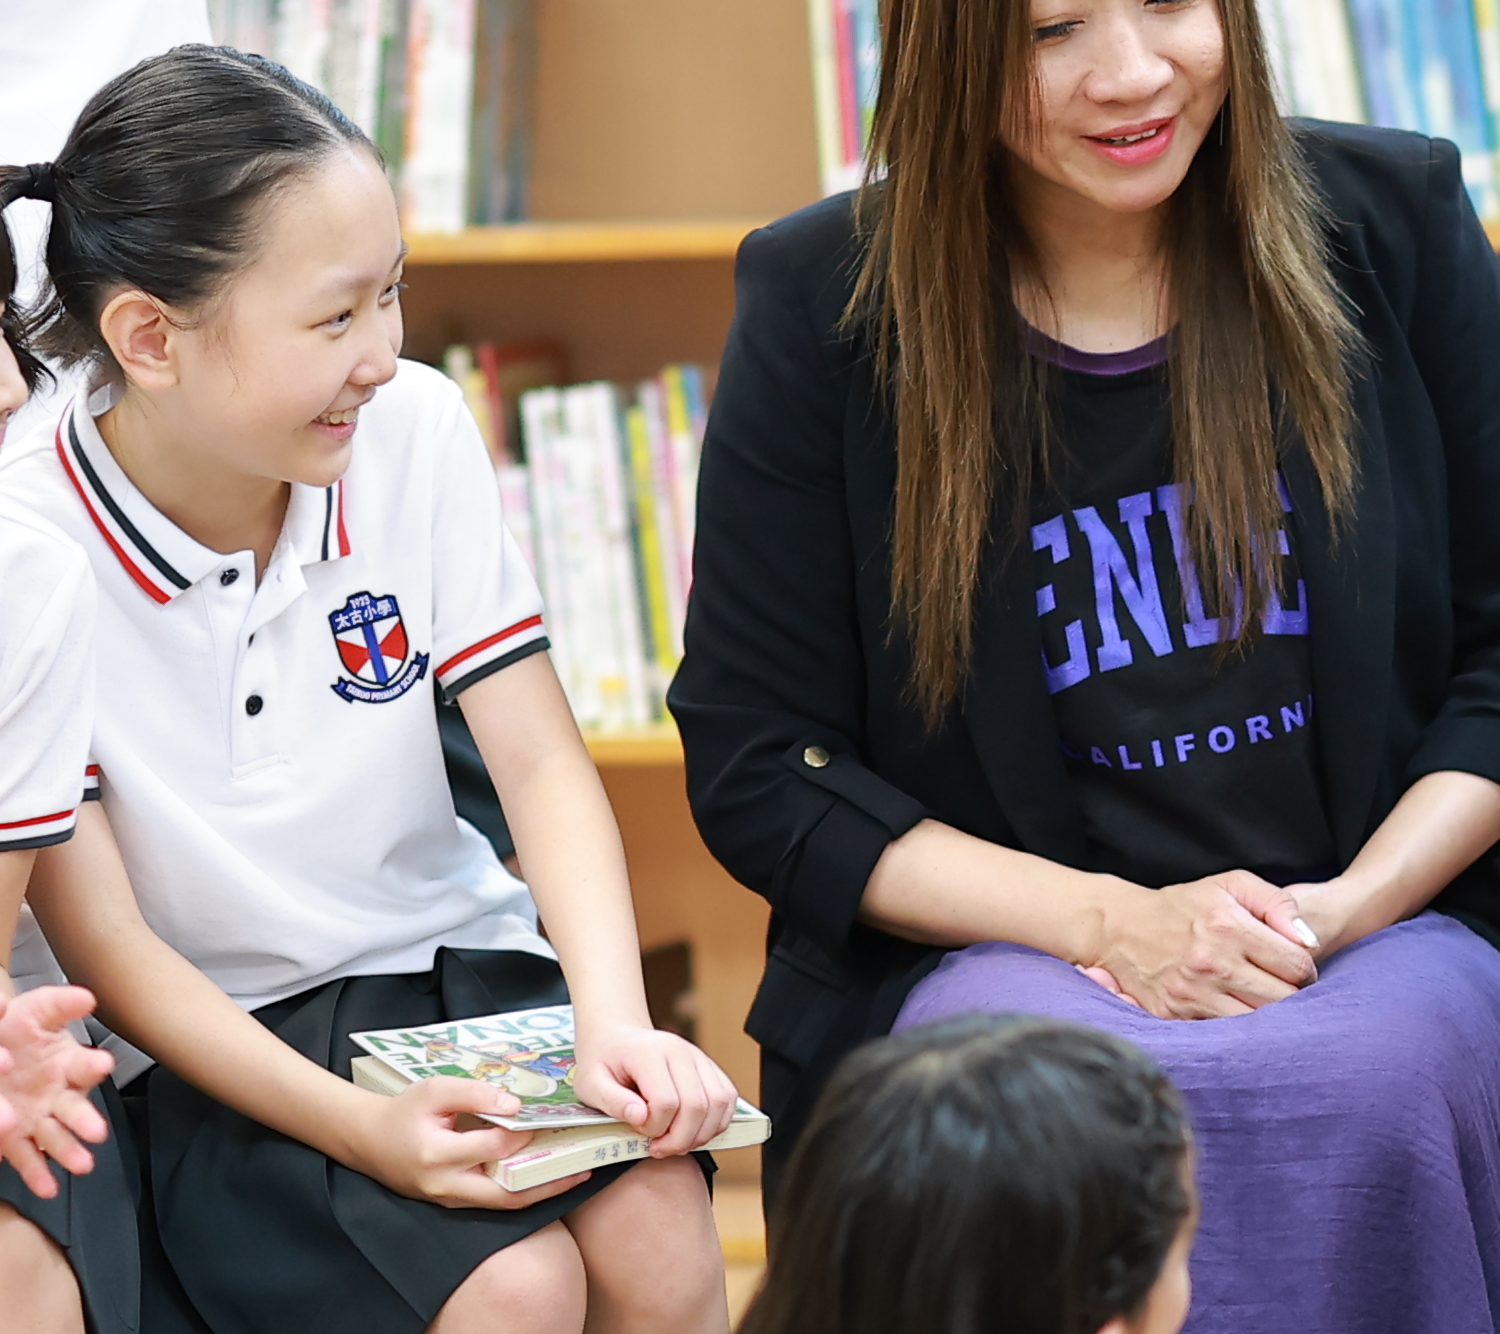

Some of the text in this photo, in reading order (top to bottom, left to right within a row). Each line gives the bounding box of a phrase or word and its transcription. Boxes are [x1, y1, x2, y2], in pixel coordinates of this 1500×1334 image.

[334, 599, 393, 631] 太古小學
[349, 594, 371, 609] 1923
[400, 663, 421, 690] SCHOOL
[1060, 693, 1313, 771] ALIFORN
[362, 1008, 574, 1052] ONAN
